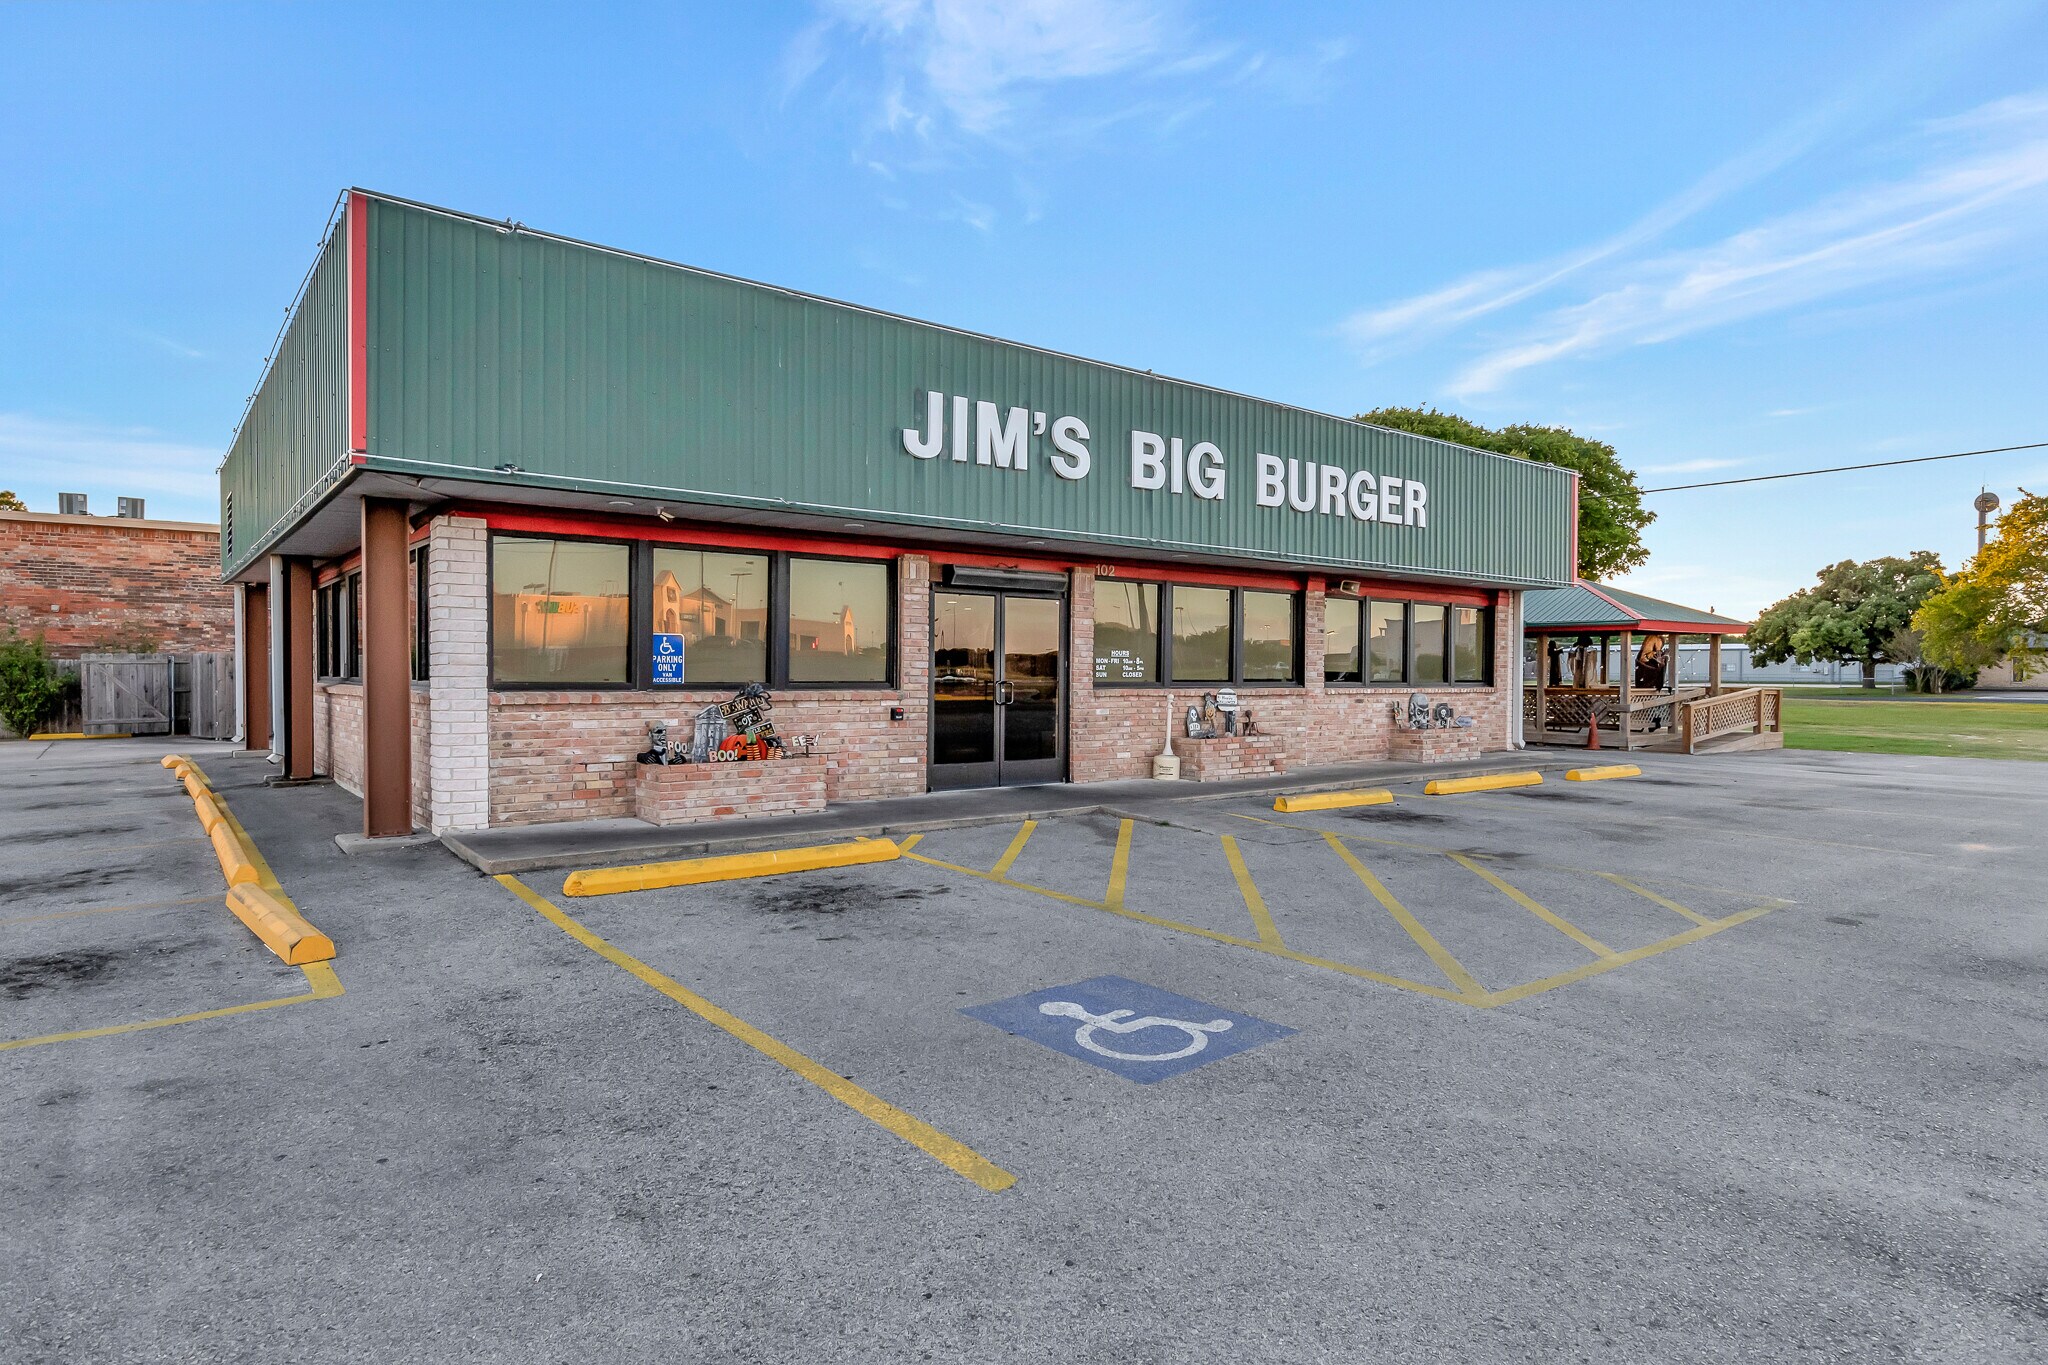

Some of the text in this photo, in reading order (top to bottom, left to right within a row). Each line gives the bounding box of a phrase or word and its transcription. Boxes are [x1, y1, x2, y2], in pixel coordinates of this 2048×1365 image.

[903, 390, 1427, 528] JIM'S BIG BURGER
[1096, 564, 1115, 577] 102
[652, 655, 683, 664] PARKING
[657, 664, 677, 672] ONLY
[708, 748, 738, 762] BOO!
